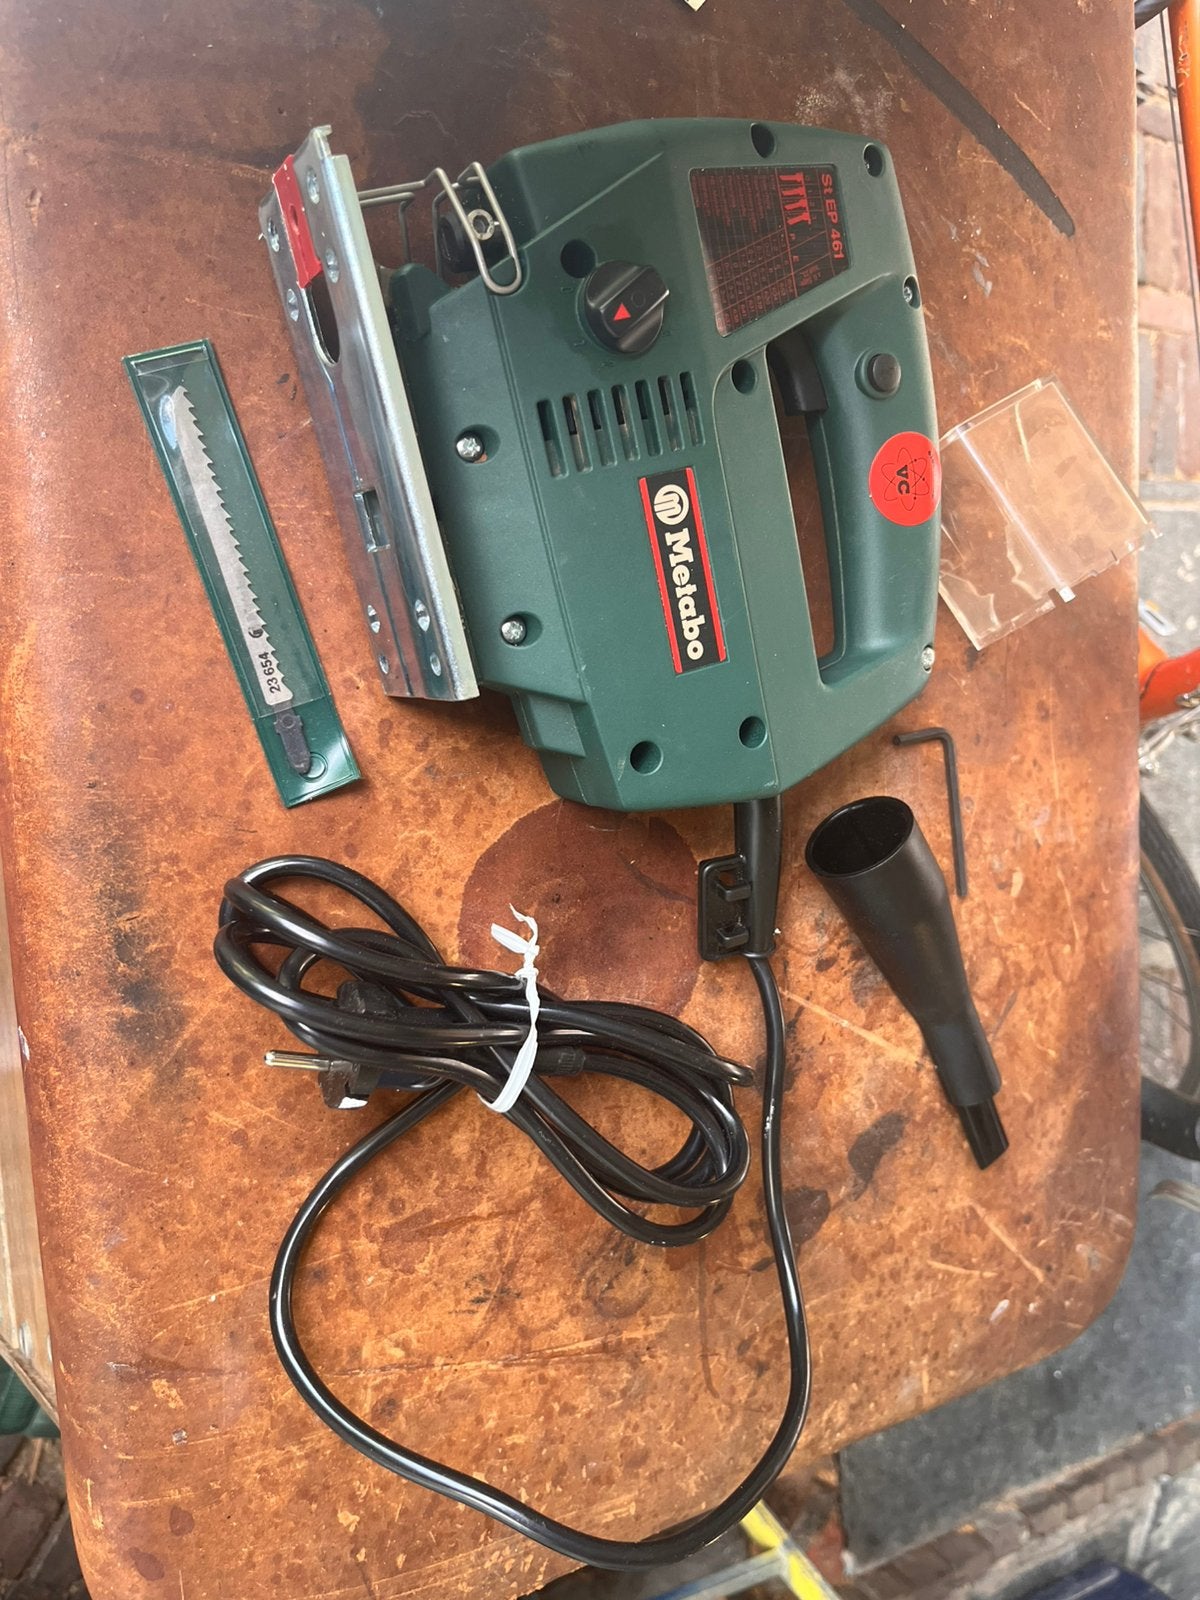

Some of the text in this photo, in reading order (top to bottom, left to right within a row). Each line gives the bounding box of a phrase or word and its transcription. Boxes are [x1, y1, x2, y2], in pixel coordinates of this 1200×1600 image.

[822, 174, 844, 259] St EP 461
[896, 464, 910, 494] VC
[664, 527, 706, 661] Metabo
